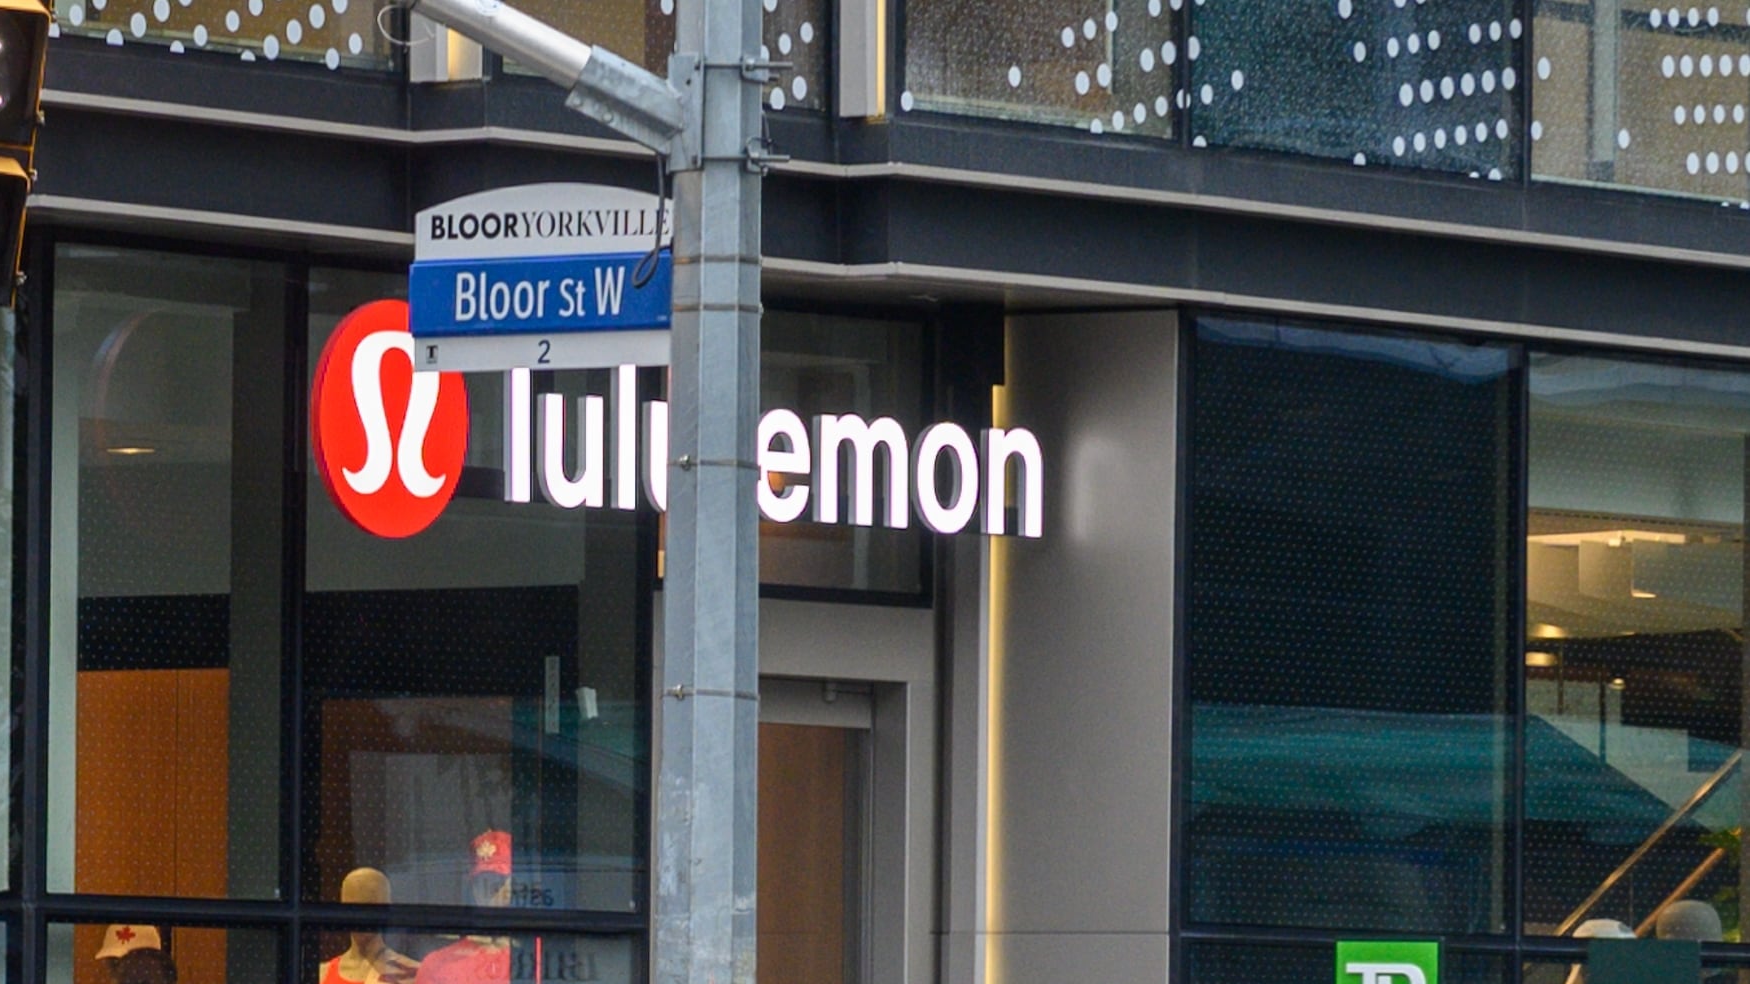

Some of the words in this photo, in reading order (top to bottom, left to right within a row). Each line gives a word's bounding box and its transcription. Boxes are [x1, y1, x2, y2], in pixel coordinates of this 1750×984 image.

[430, 208, 671, 241] BLOORYORKVILLE
[455, 271, 551, 321] Bloor
[559, 277, 587, 317] St
[595, 266, 626, 316] W
[538, 340, 551, 364] 2
[507, 363, 1043, 538] lulemon
